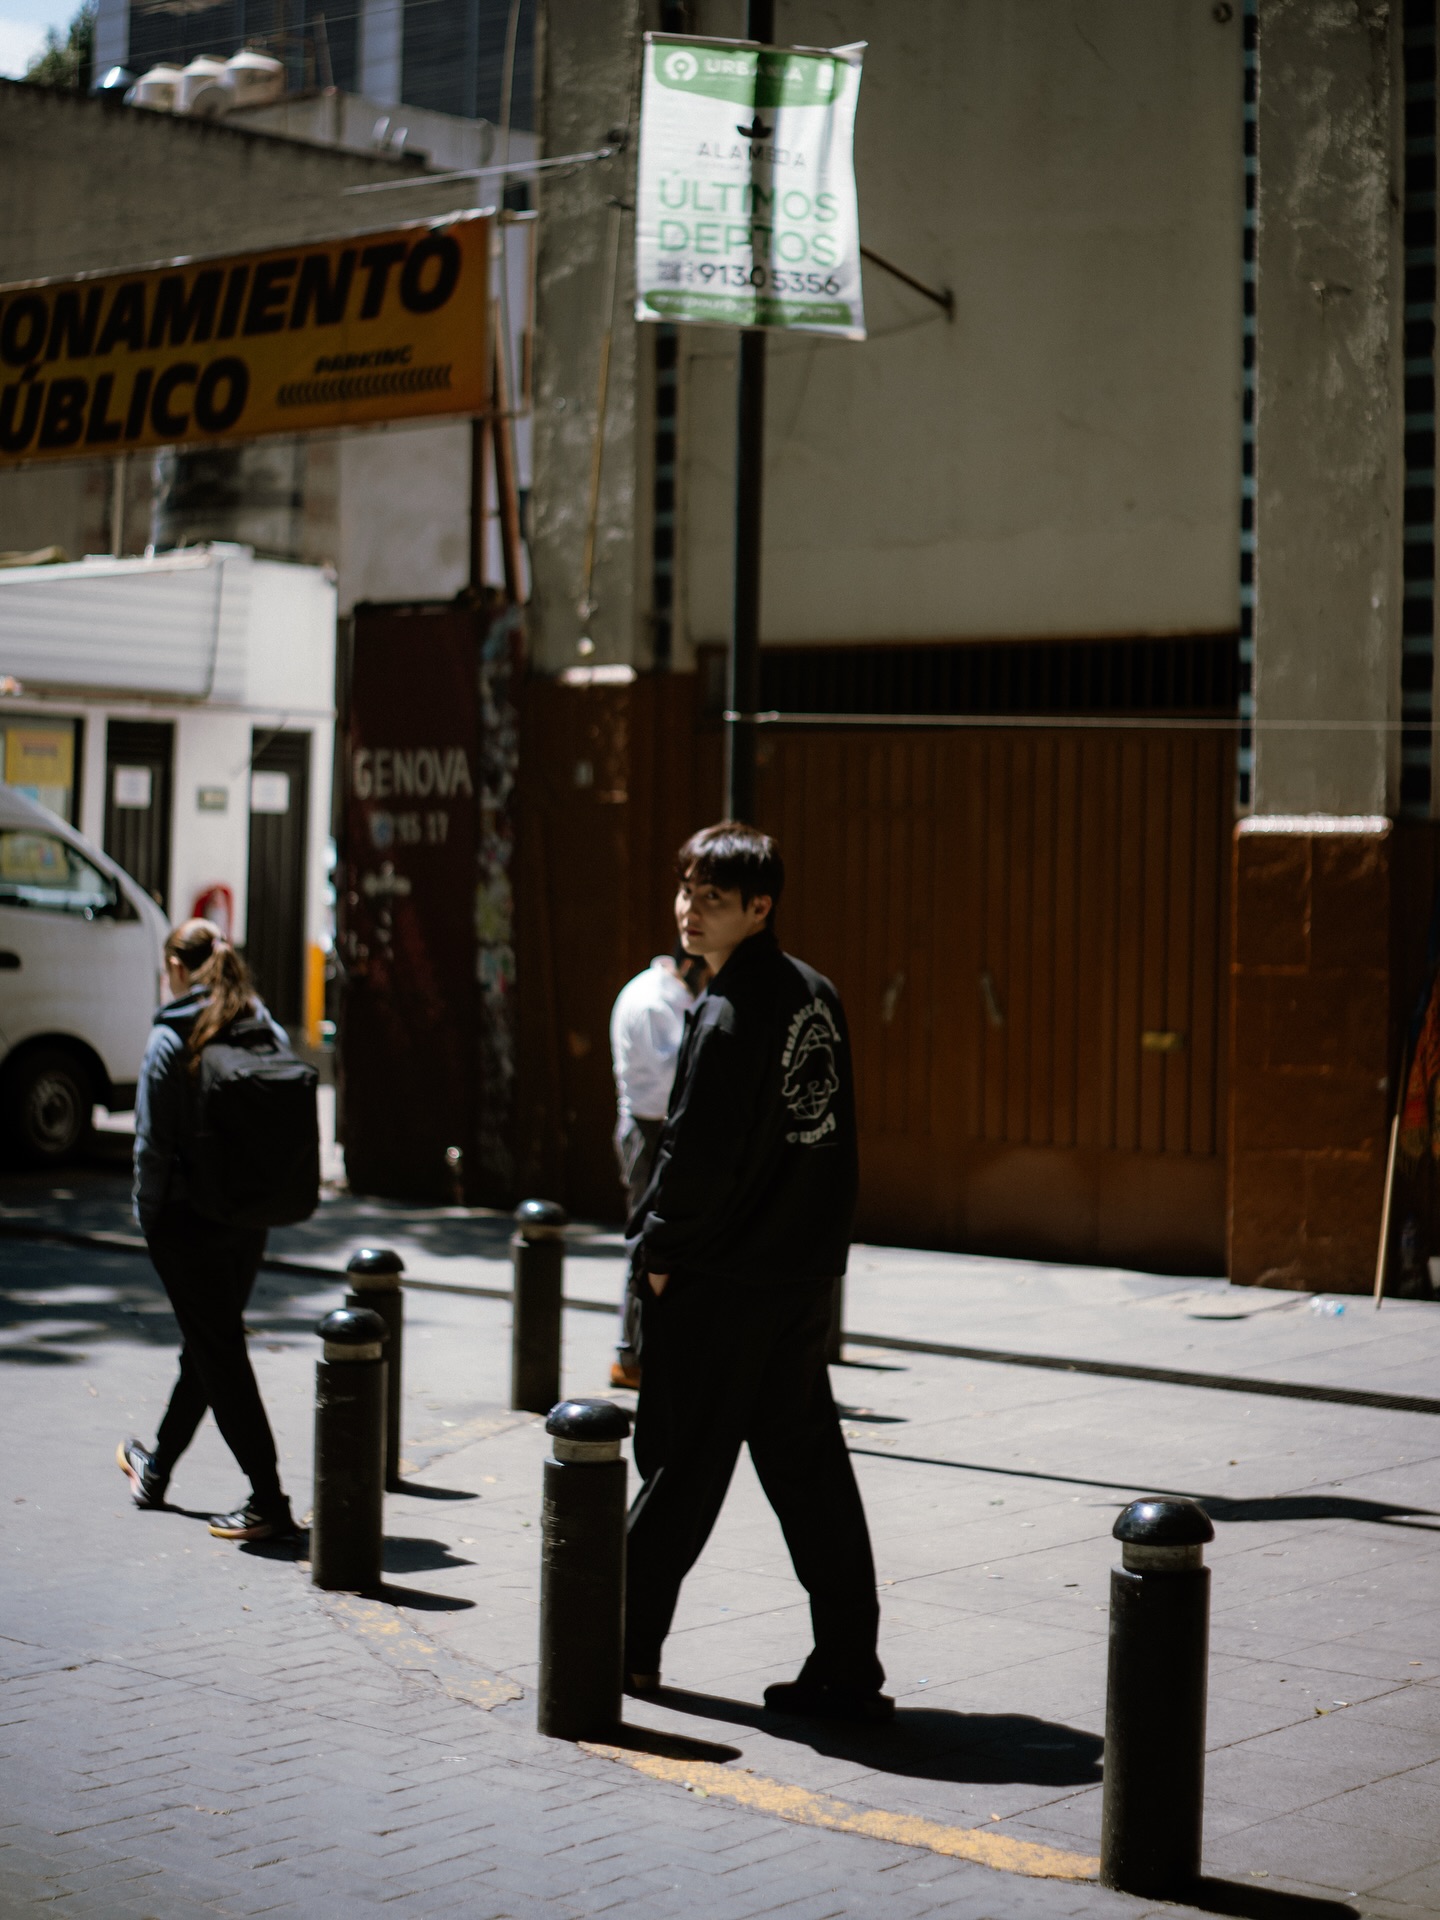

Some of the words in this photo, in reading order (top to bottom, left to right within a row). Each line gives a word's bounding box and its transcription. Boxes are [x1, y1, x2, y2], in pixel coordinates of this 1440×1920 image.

[698, 142, 806, 168] ALAMEDA
[658, 169, 838, 223] ÚLTIMOS
[658, 219, 838, 267] DEPTOS
[0, 356, 249, 453] ÚBLICO
[353, 747, 473, 799] GENOVA
